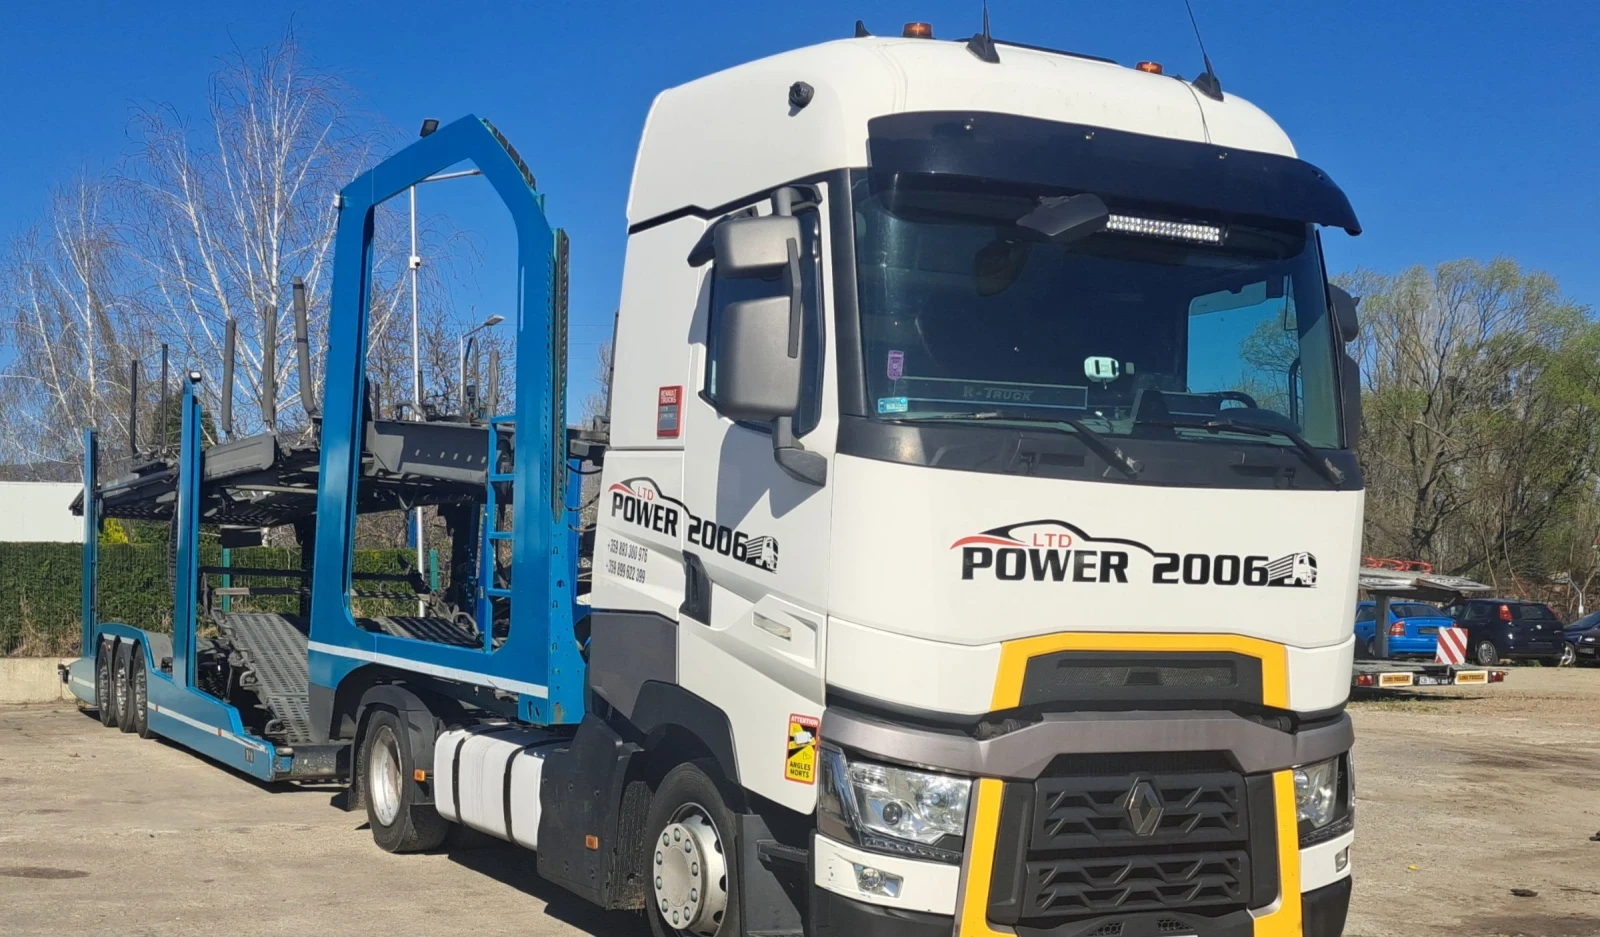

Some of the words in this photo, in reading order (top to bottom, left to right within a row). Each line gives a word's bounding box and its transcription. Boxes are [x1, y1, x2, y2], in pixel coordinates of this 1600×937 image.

[637, 486, 654, 501] LTD
[611, 492, 678, 537] POWER
[687, 515, 749, 562] 2006
[1032, 533, 1072, 548] LTD
[626, 564, 636, 581] 622
[961, 547, 1129, 583] POWER
[1152, 552, 1270, 587] 2006
[791, 715, 819, 726] ATTENTION
[789, 760, 811, 771] ANGLES
[789, 768, 810, 779] MORTS
